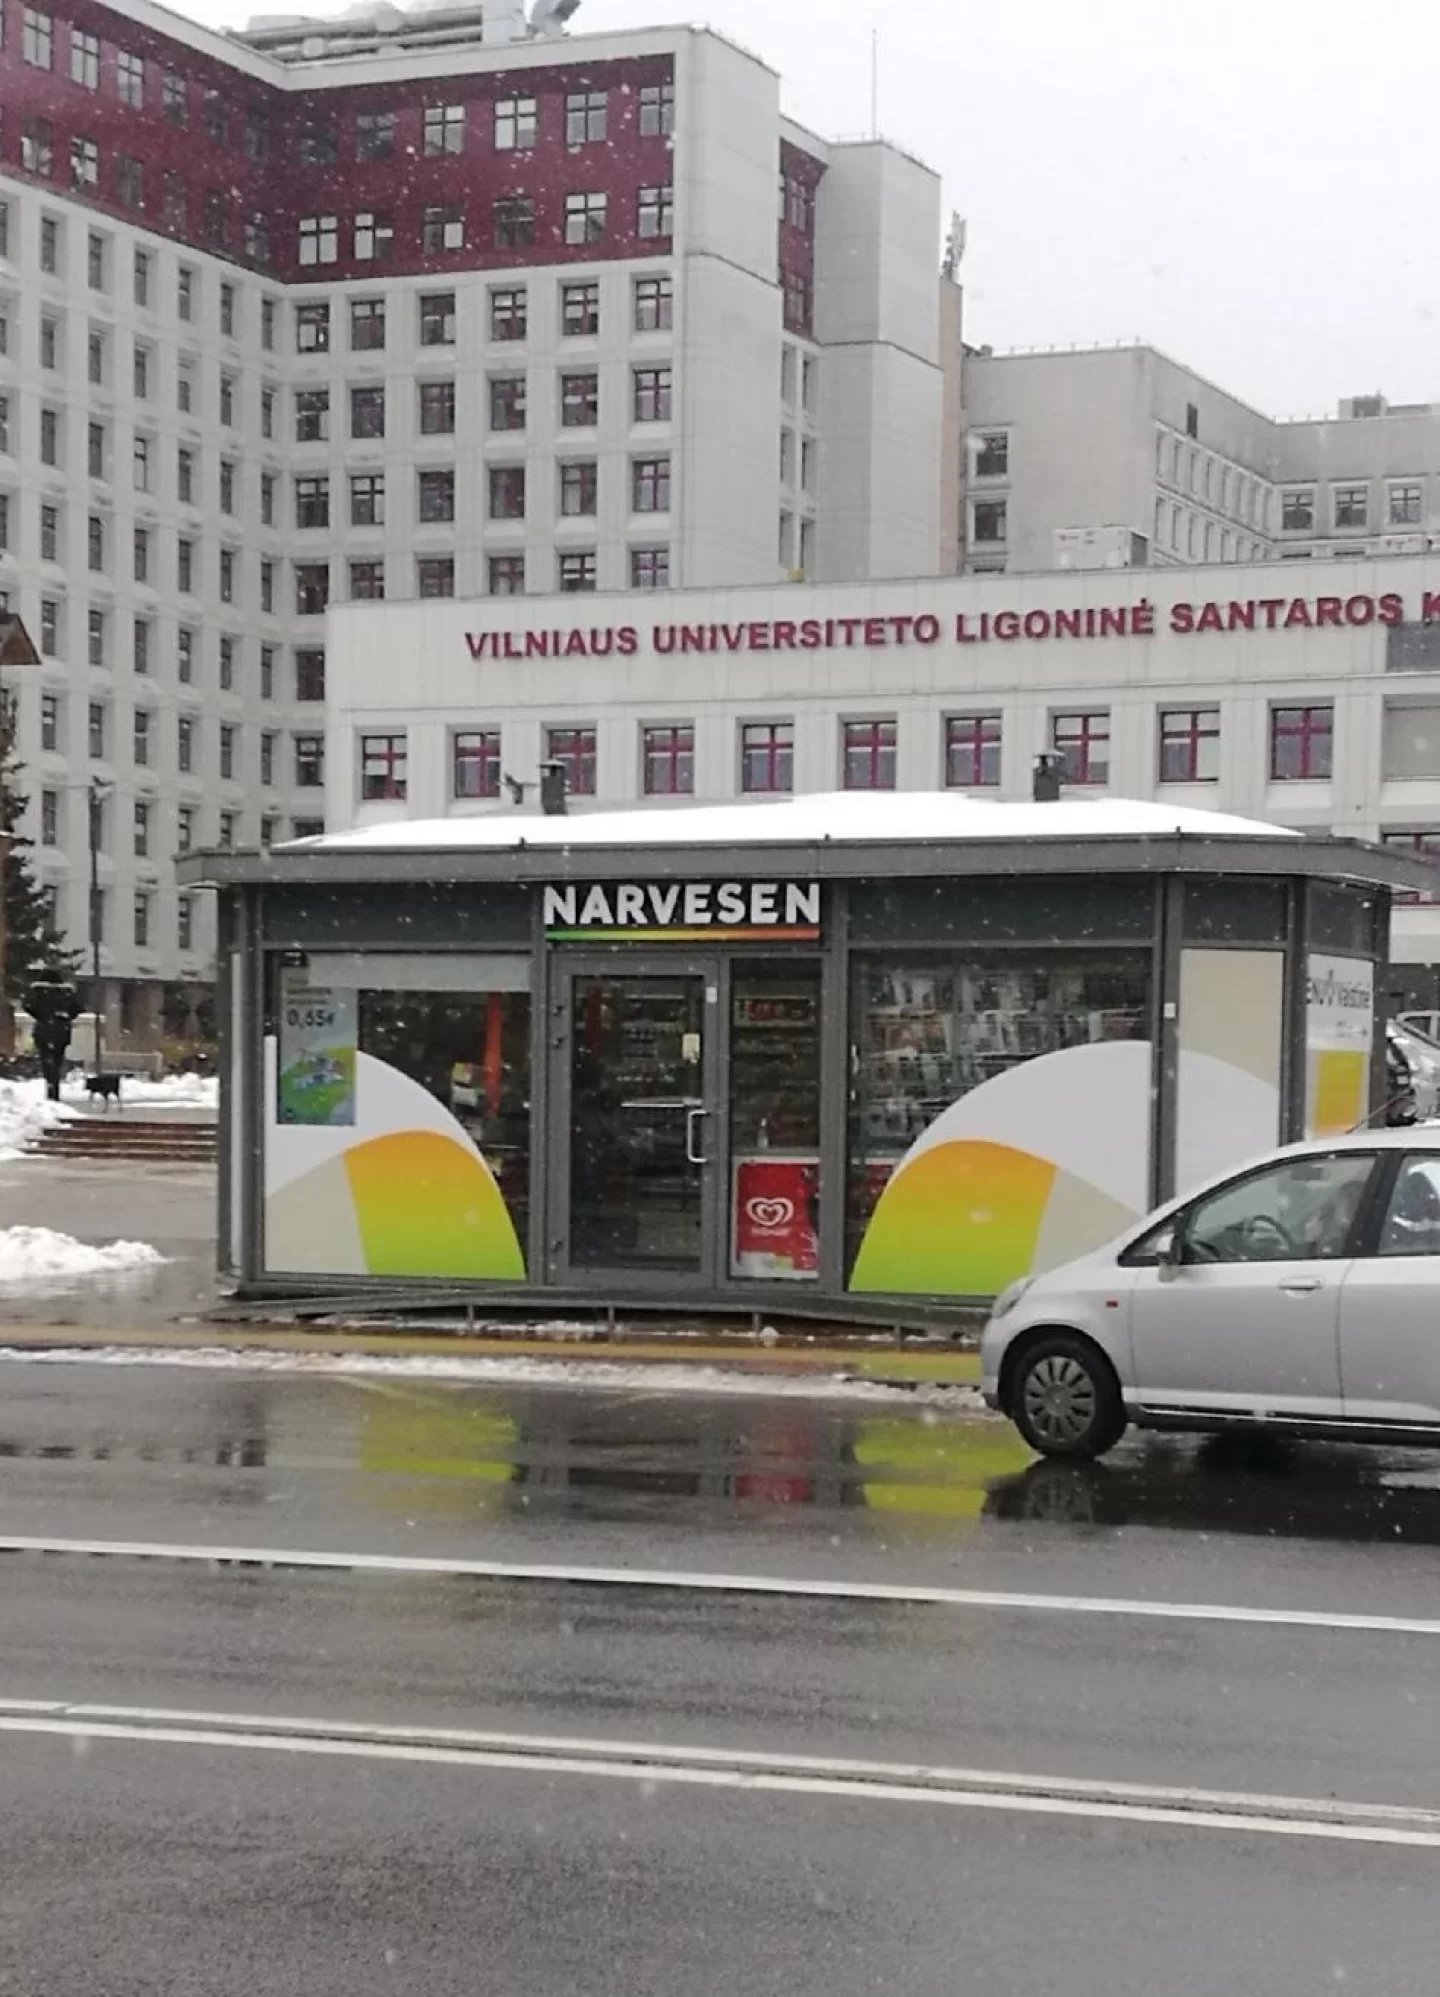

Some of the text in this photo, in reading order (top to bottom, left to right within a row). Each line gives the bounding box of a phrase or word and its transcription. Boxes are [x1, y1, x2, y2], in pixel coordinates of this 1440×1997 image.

[465, 627, 638, 659] VILNIAUS
[653, 615, 939, 654] UNIVERSITETO
[955, 597, 1155, 643] LIGONINĖ
[1170, 593, 1404, 633] SANTAROS
[543, 883, 820, 925] NARVESEN
